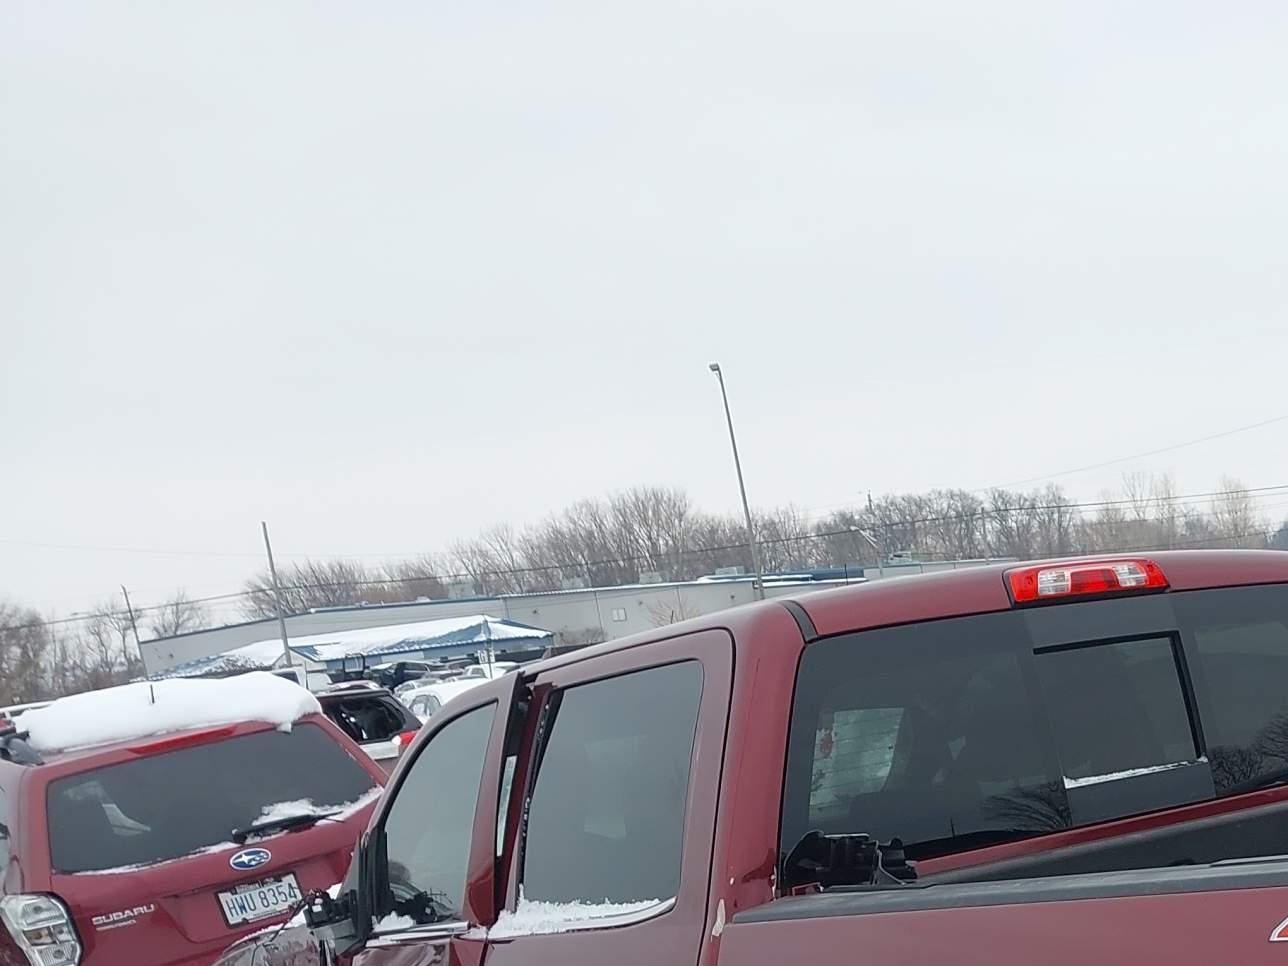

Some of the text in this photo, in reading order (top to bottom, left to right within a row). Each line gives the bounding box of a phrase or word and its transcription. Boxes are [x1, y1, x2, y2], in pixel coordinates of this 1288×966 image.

[92, 902, 156, 925] SUBARU
[225, 893, 257, 918] HWU
[257, 882, 298, 908] 8354
